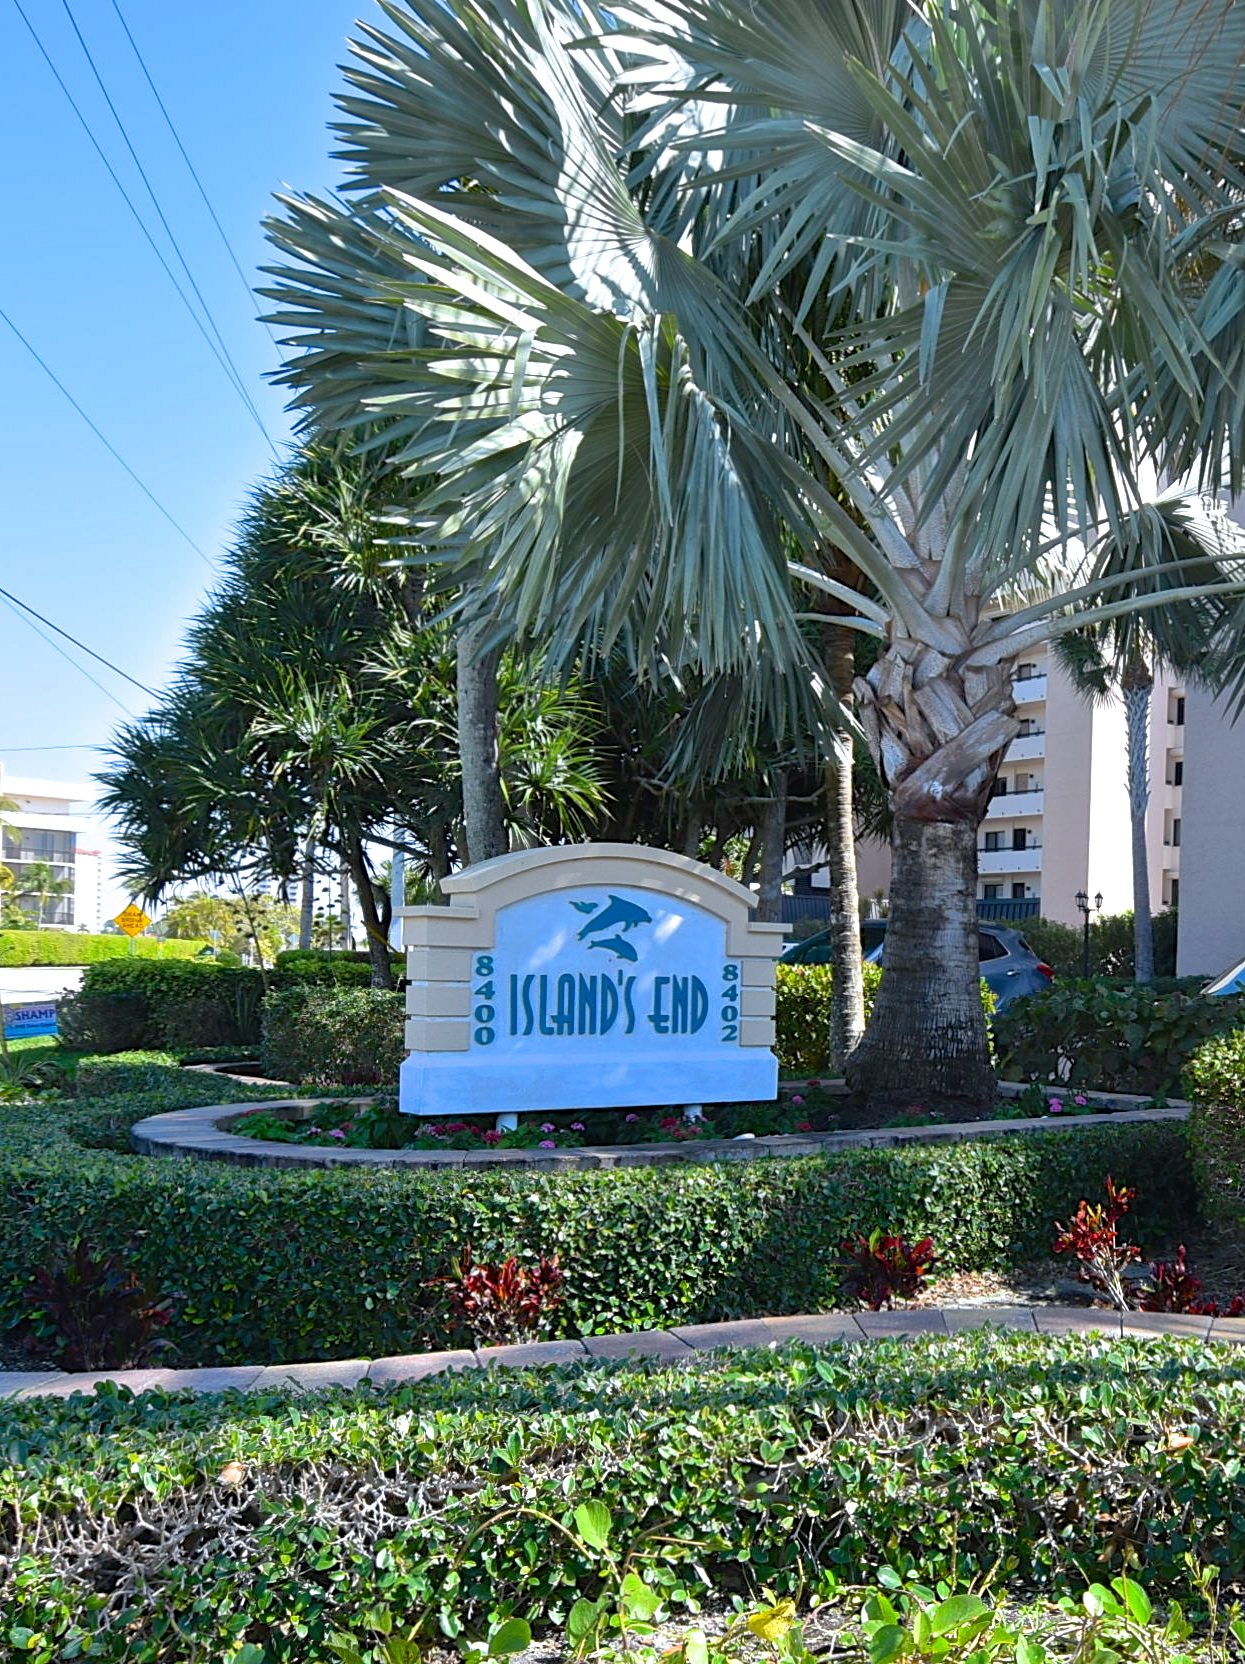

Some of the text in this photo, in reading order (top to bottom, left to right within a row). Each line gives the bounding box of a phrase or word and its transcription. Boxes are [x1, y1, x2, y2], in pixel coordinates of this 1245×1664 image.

[474, 955, 496, 1046] 8400
[509, 969, 709, 1036] ISLAND'S END
[721, 964, 739, 1042] 8402
